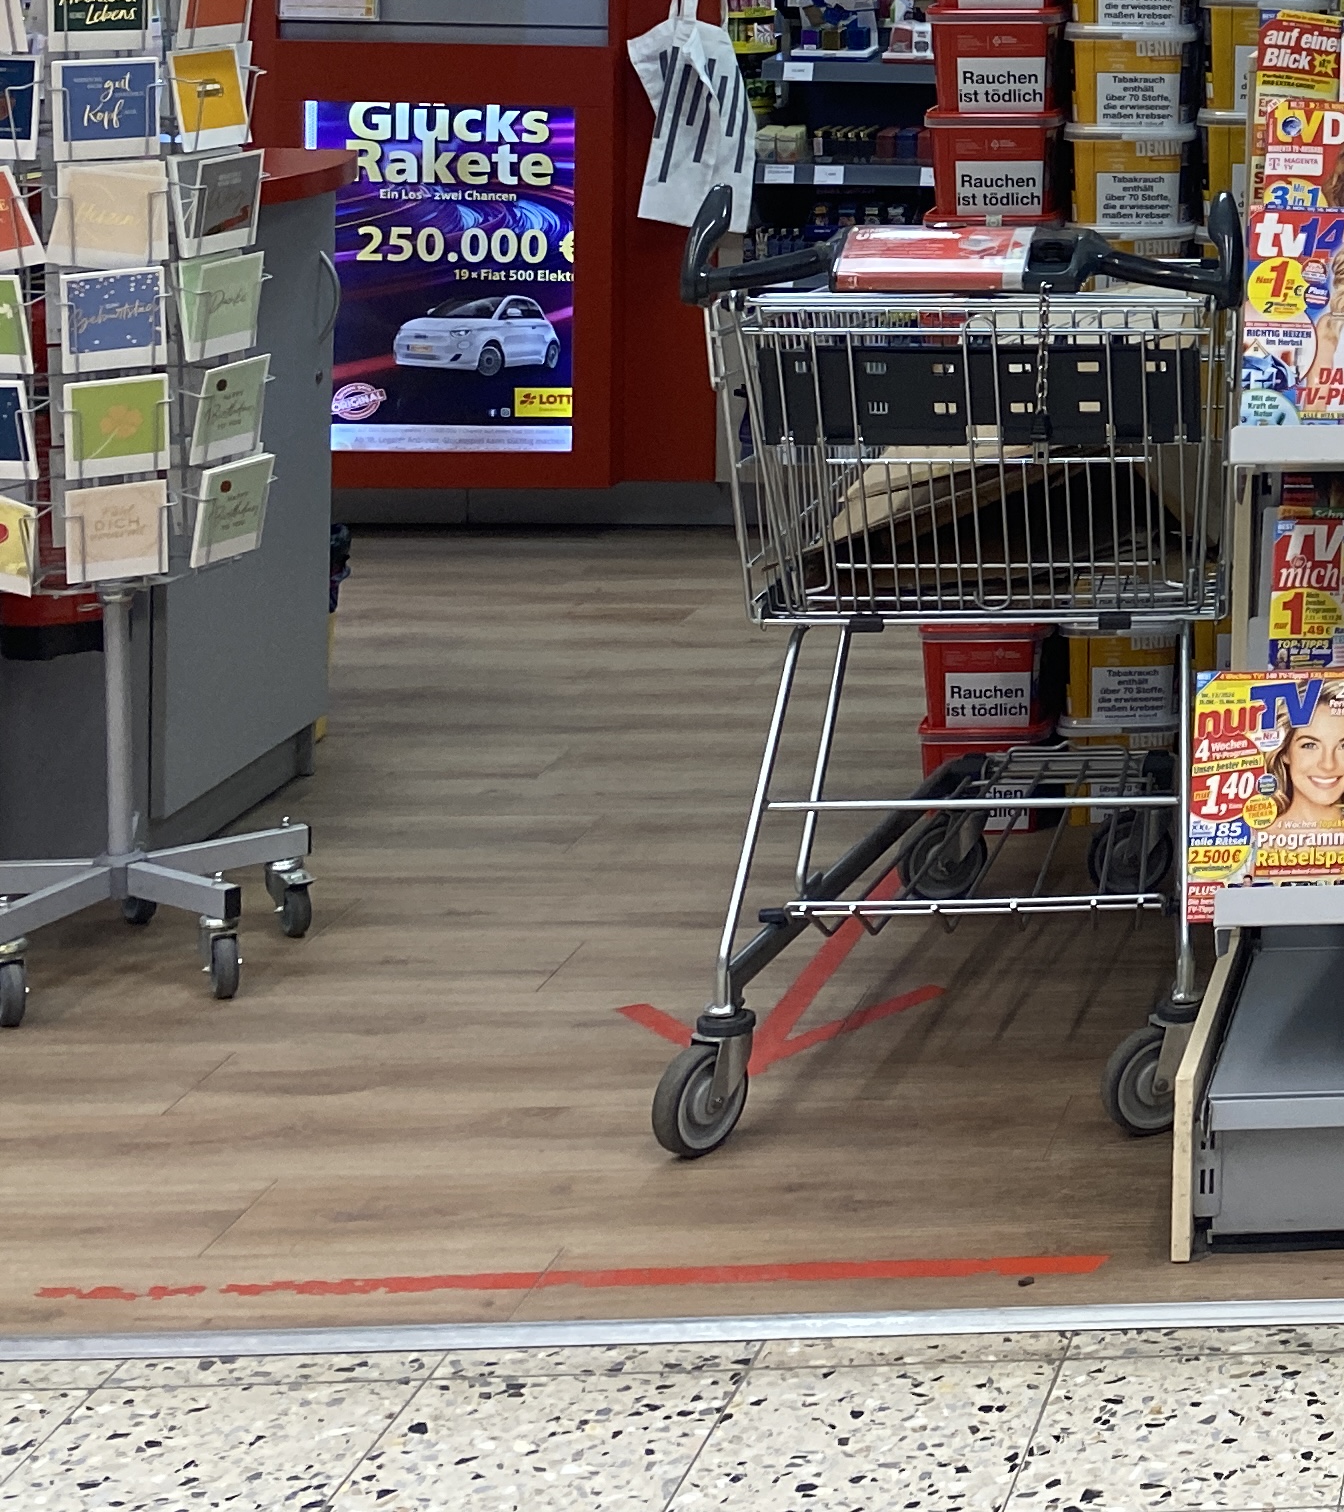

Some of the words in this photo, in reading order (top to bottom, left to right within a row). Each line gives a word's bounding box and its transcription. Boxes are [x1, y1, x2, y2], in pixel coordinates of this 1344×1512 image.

[85, 4, 138, 25] Lebens
[1263, 28, 1300, 47] auf
[1262, 47, 1312, 71] Blick
[104, 70, 132, 101] gut
[83, 100, 125, 128] Kopf
[347, 100, 550, 144] Glücks
[346, 140, 555, 187] Rakete
[379, 189, 398, 201] Ein
[401, 189, 423, 201] Los
[434, 190, 462, 202] zwei
[464, 190, 518, 203] Chancen
[356, 226, 549, 264] 250.000
[453, 269, 470, 281] 19
[480, 269, 506, 282] Fiat
[509, 269, 535, 282] 500
[1279, 566, 1340, 589] mich
[1198, 702, 1267, 738] nur
[1250, 678, 1325, 730] TV
